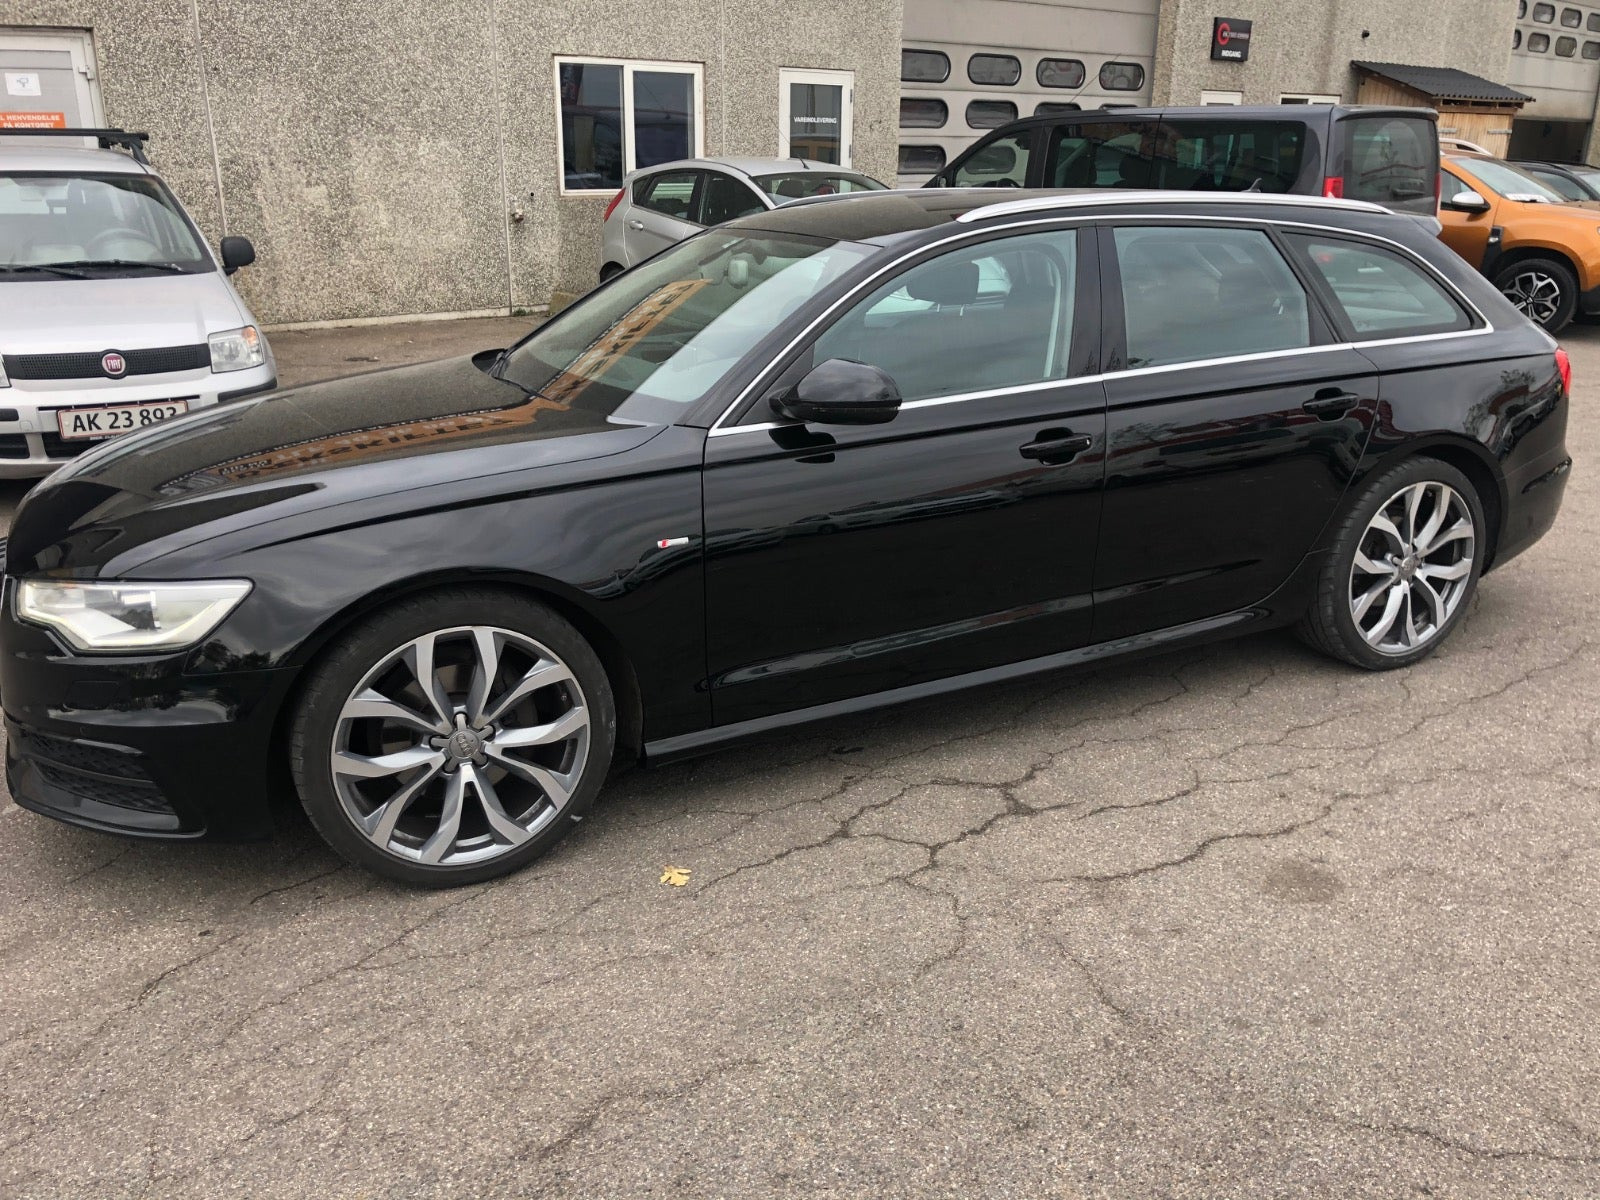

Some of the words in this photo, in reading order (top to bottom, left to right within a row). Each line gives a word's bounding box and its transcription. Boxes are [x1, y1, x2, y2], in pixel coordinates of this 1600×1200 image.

[106, 360, 121, 370] FIAT
[73, 413, 102, 432] AK
[107, 410, 134, 430] 23
